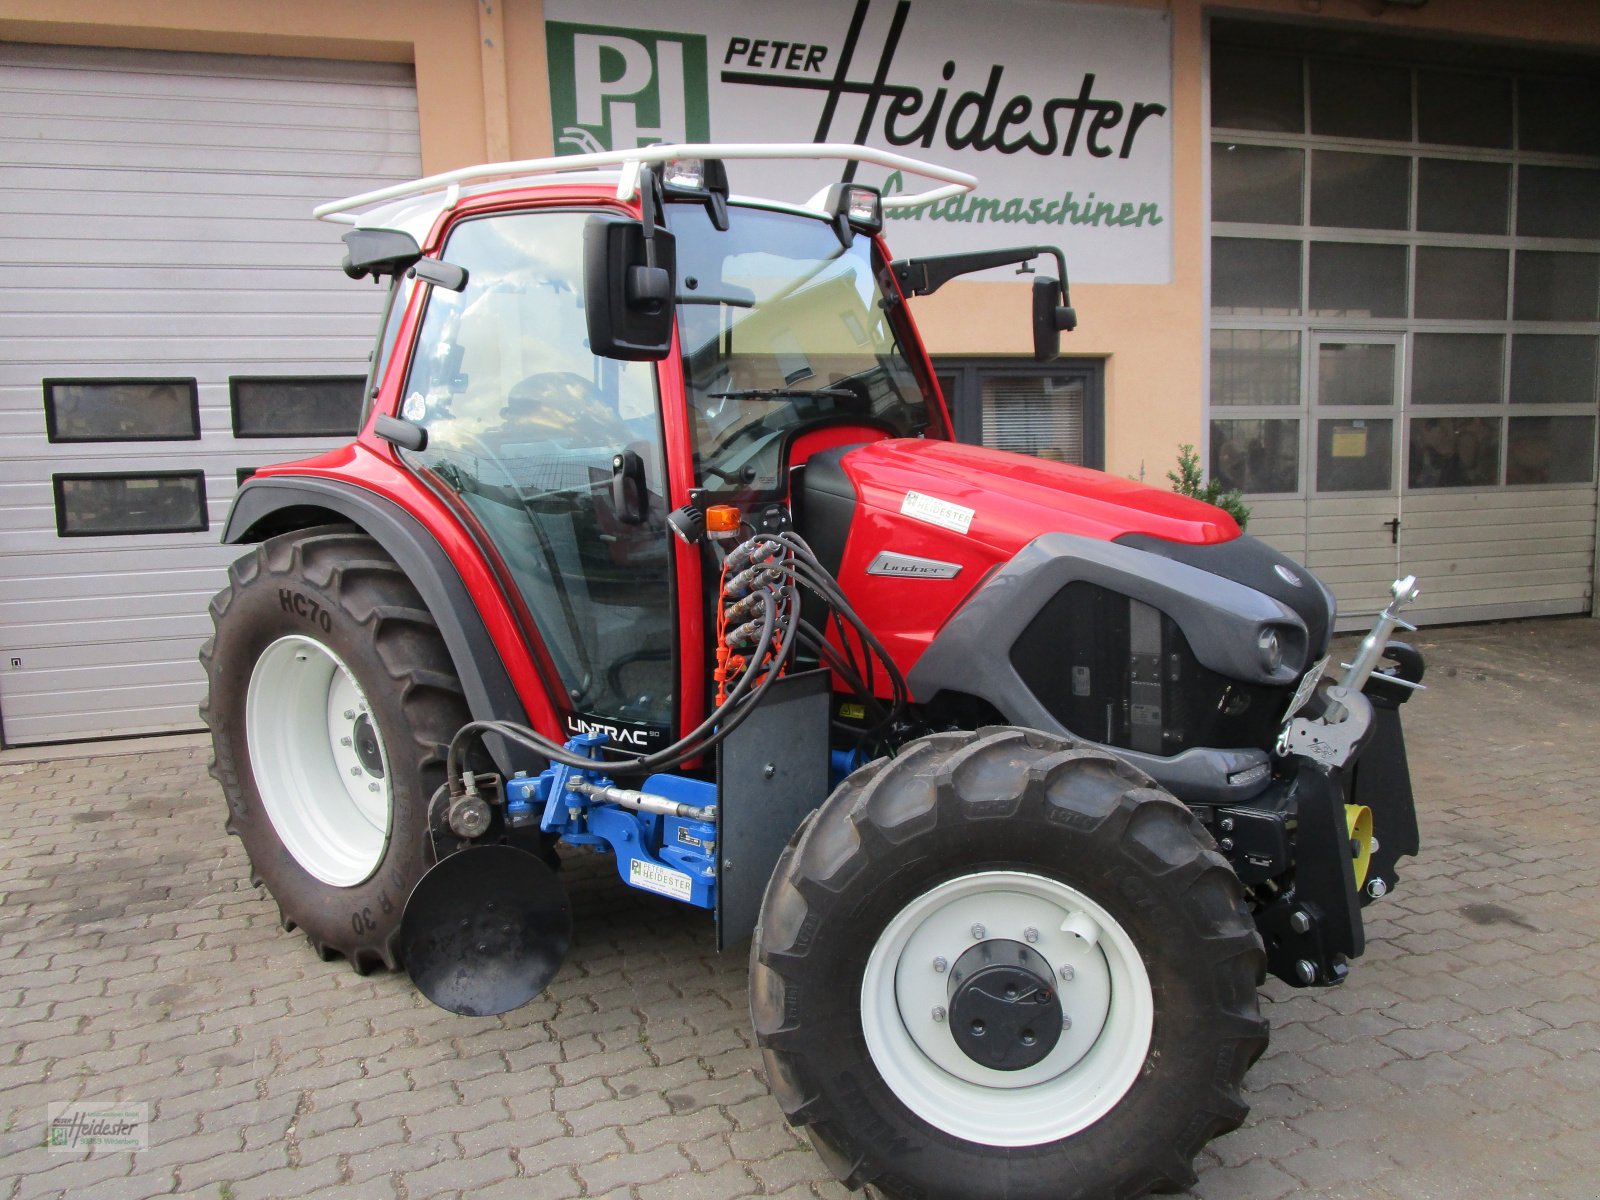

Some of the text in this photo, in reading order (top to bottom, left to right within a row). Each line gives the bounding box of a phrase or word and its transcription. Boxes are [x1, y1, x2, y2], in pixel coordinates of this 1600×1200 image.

[724, 36, 828, 73] PETER
[806, 0, 1167, 184] Heidester
[916, 500, 971, 525] HEIDESTER
[882, 562, 945, 574] Lindner
[278, 588, 332, 633] HC70
[567, 715, 648, 746] LINTRAC
[643, 870, 691, 891] HEIDESTER
[351, 906, 377, 936] 30
